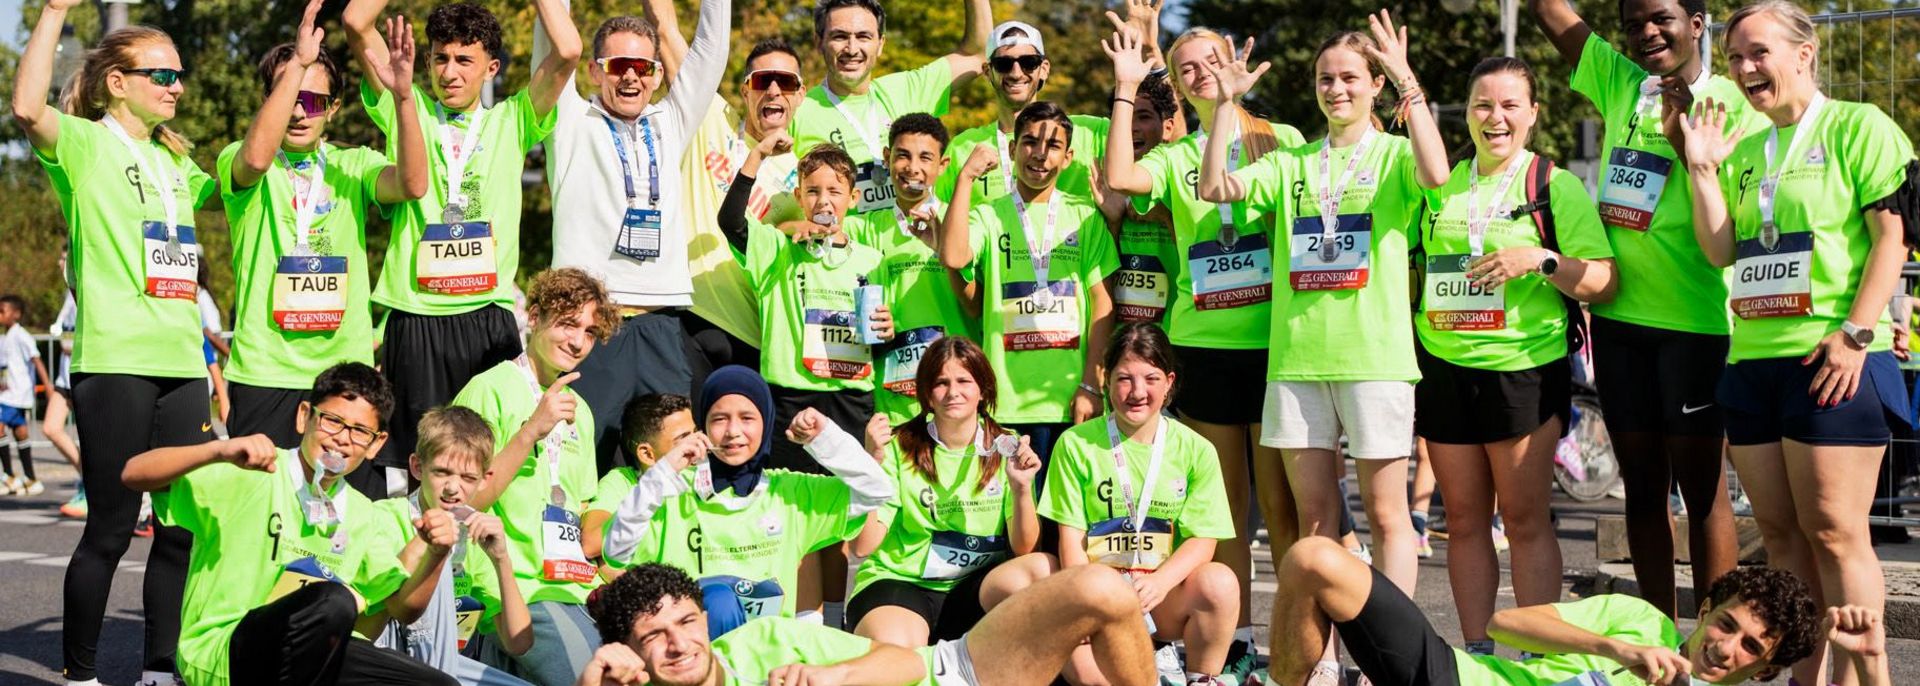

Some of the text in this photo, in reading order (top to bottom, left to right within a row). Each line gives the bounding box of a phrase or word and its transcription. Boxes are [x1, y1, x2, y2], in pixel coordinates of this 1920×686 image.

[1610, 167, 1648, 189] 2848
[431, 241, 483, 259] TAUB
[1308, 234, 1355, 251] 269
[152, 248, 196, 268] GUDE
[1206, 253, 1255, 274] 2864
[1313, 272, 1359, 282] GENERALI
[1740, 261, 1800, 283] GUIDE
[288, 276, 338, 292] TAUB
[442, 276, 488, 288] GENERALI
[1219, 286, 1266, 301] GENERALI
[1751, 296, 1799, 309] GENERALI
[1119, 305, 1156, 318] ENERALI
[1447, 312, 1495, 323] GENERALI
[821, 327, 860, 345] 1112
[1105, 536, 1153, 551] 11195
[947, 550, 992, 568] 2947
